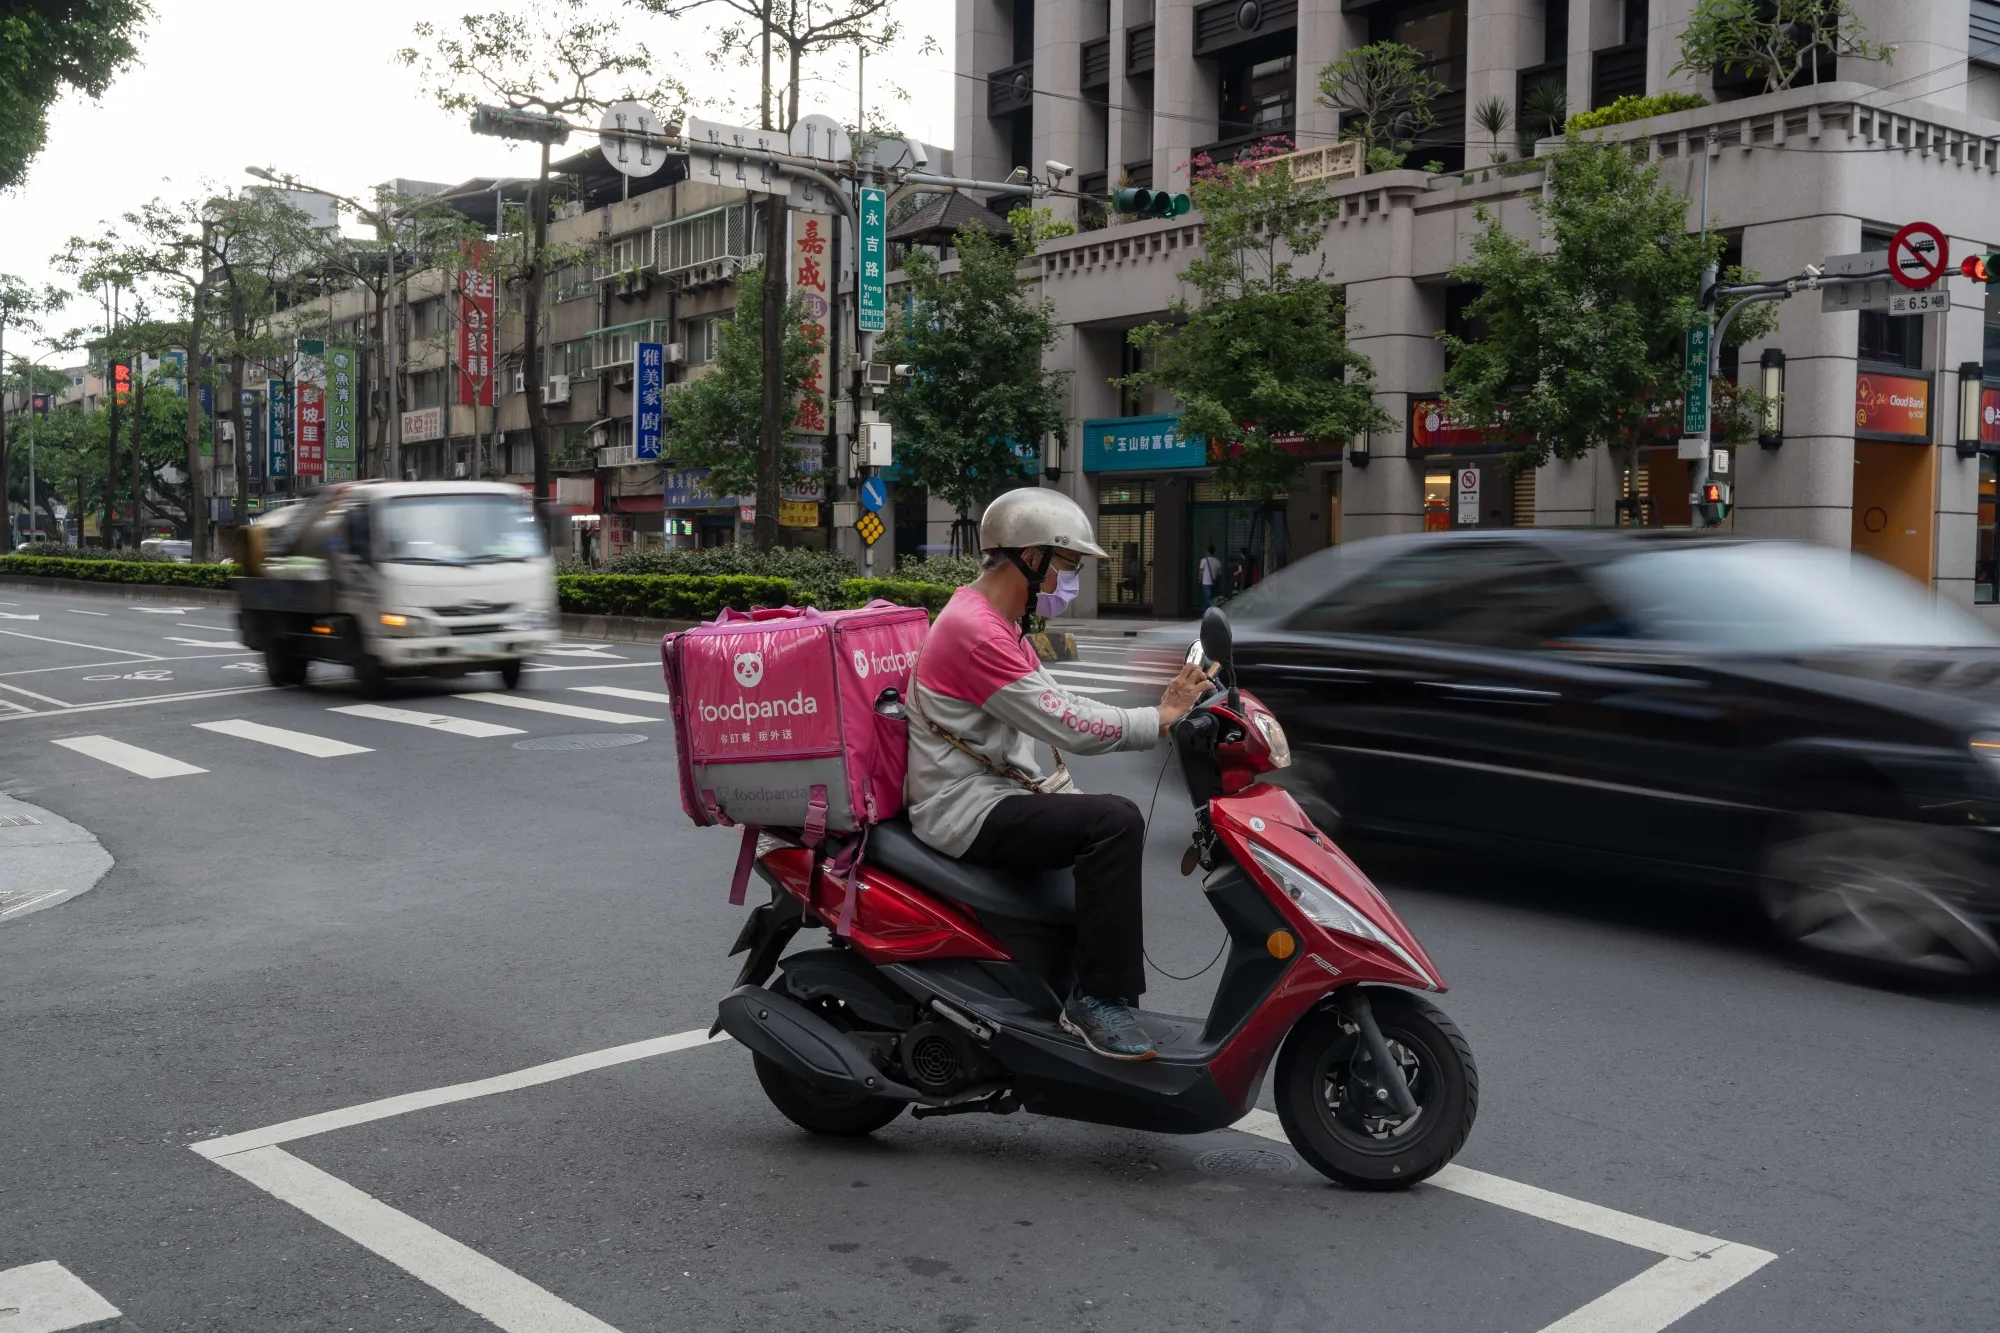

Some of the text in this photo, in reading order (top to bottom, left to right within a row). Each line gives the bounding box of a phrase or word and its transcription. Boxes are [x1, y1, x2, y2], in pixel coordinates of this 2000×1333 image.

[865, 209, 879, 278] 永吉路
[863, 284, 882, 294] Yong
[863, 291, 870, 299] Ji
[863, 299, 875, 307] Rd.
[1909, 296, 1928, 310] 6.5
[467, 308, 489, 377] 全家福
[1690, 330, 1704, 388] 虎林街
[641, 349, 660, 455] 雅美家廚具
[1890, 394, 1909, 407] Cloud
[1909, 397, 1925, 409] Bank
[1117, 433, 1187, 452] 玉山財富管理
[698, 691, 818, 726] foodpanda
[1060, 707, 1122, 742] foodpa
[758, 729, 793, 743] 我外送
[734, 786, 808, 804] foodpanda
